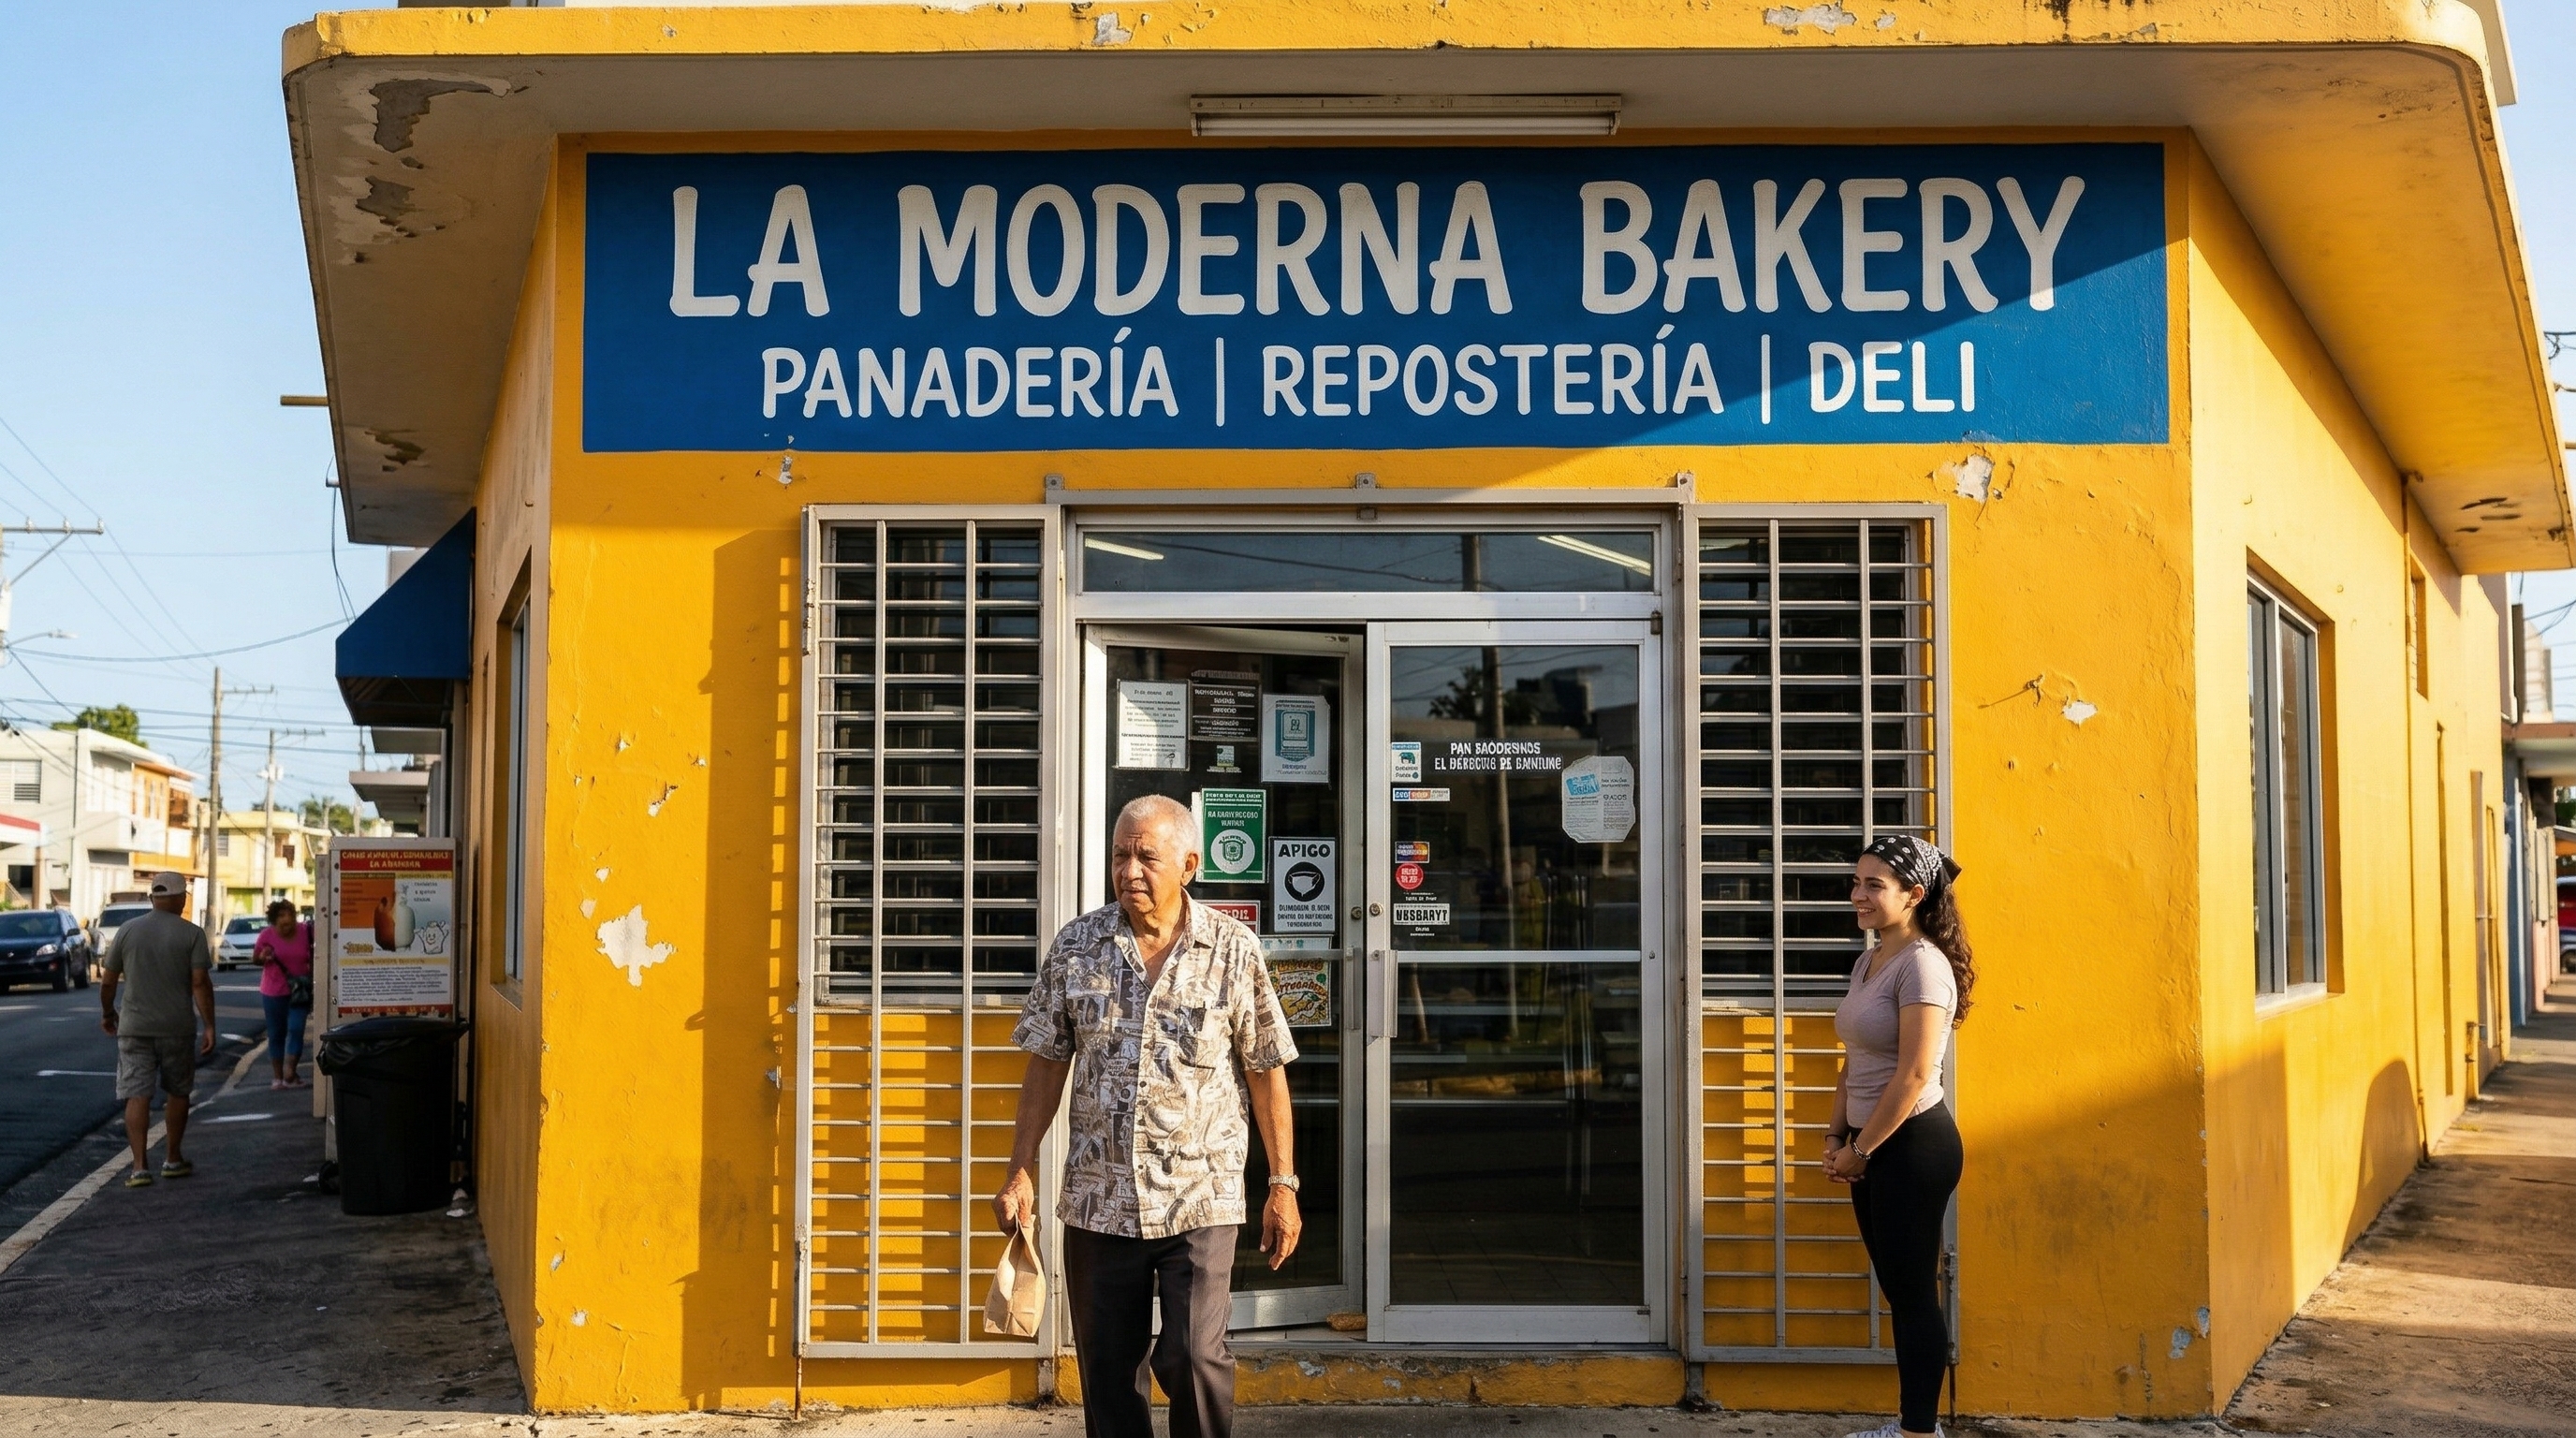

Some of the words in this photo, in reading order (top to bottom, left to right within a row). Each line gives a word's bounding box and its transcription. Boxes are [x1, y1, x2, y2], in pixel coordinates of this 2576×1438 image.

[669, 184, 831, 318] LA
[896, 181, 1514, 318] MODERNA
[1579, 175, 2087, 315] BAKERY
[761, 326, 1180, 419] PANADERÍA
[1261, 322, 1726, 418] REPOSTERÍA
[1807, 340, 1976, 414] DELI
[1450, 742, 1471, 755] PAN
[1434, 757, 1446, 770] EL
[1278, 844, 1331, 858] APIGO
